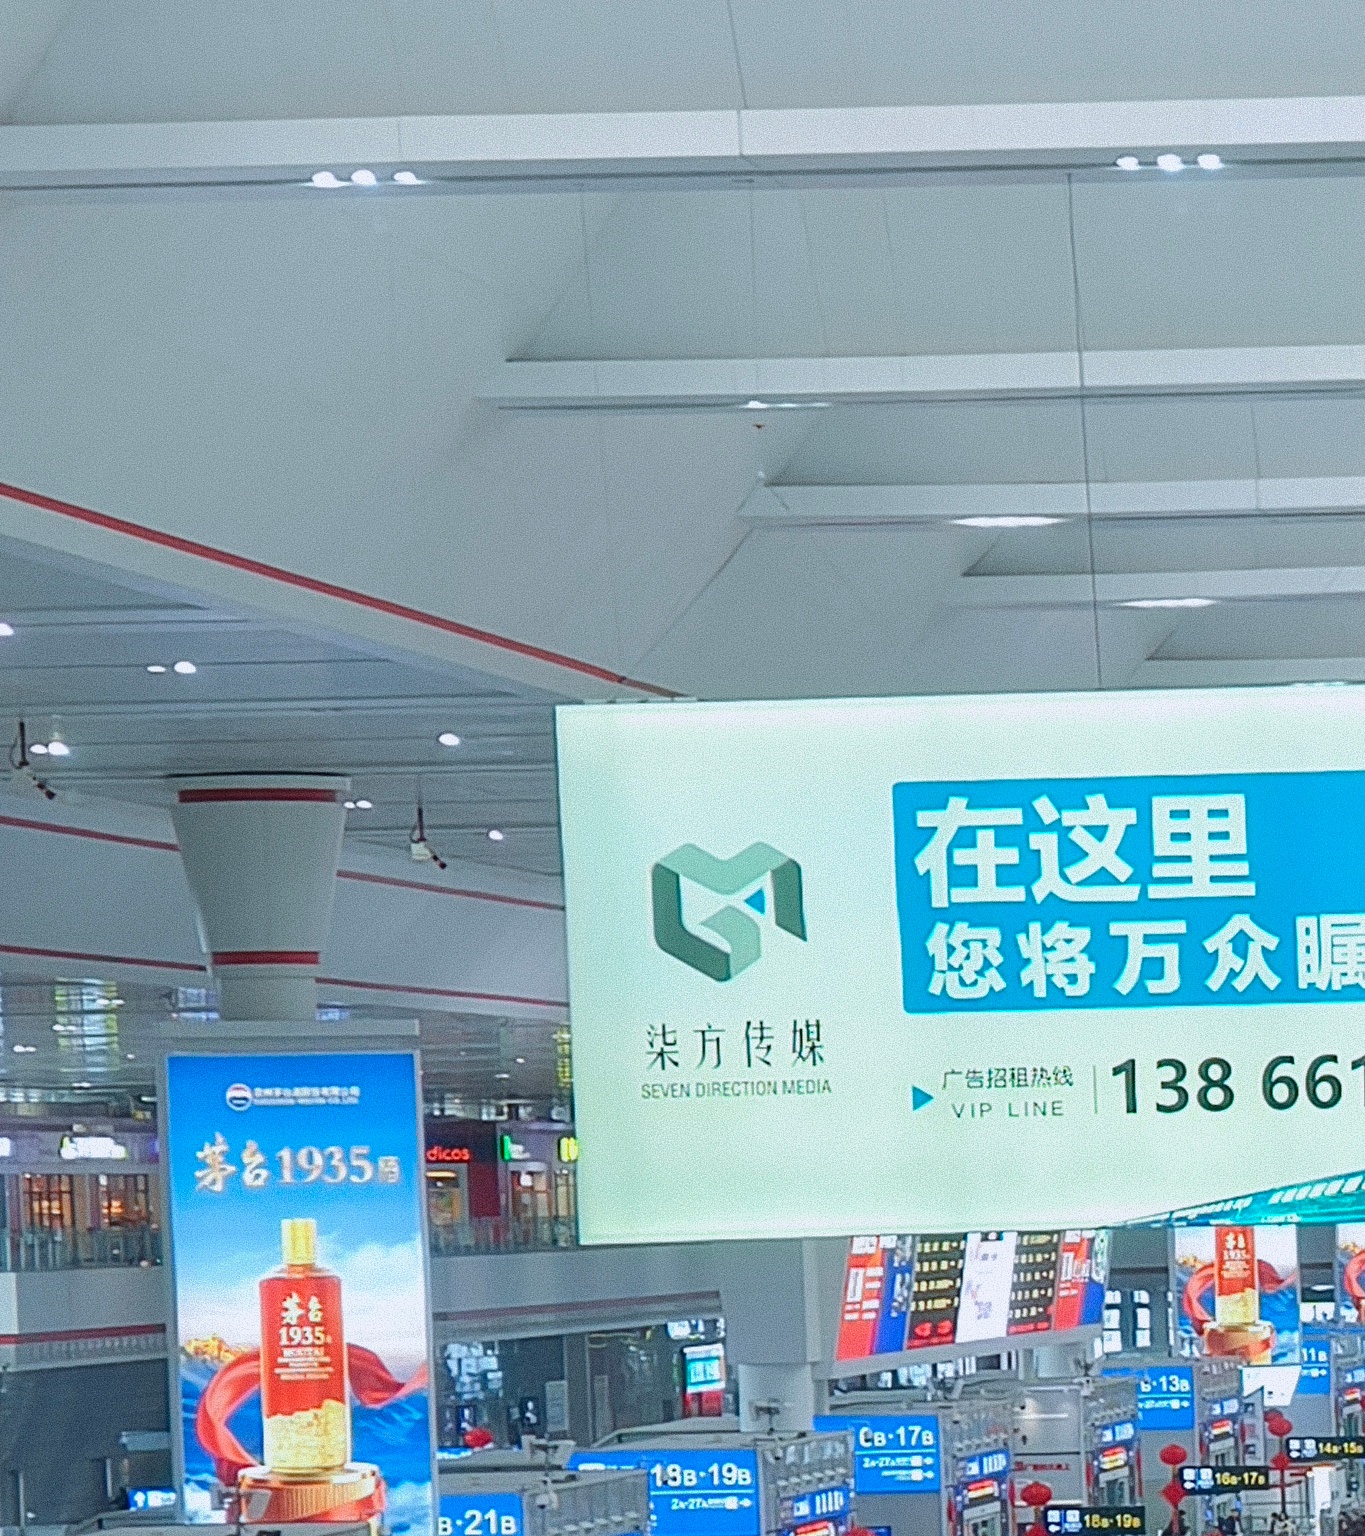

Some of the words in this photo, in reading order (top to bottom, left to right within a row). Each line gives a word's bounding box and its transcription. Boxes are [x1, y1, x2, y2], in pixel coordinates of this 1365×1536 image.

[913, 793, 1257, 909] 在这里
[646, 1019, 825, 1071] 柒方传媒
[641, 1082, 691, 1100] SEVEN
[695, 1079, 778, 1099] DIRECTION
[782, 1078, 833, 1096] MEDIA
[942, 1065, 1074, 1090] 广告招租热线
[1112, 1057, 1235, 1114] 138
[951, 1102, 993, 1118] VIP
[1008, 1100, 1065, 1117] LINE
[426, 1146, 471, 1161] dicos
[279, 1326, 325, 1346] 1935
[438, 1508, 517, 1536] B·21B
